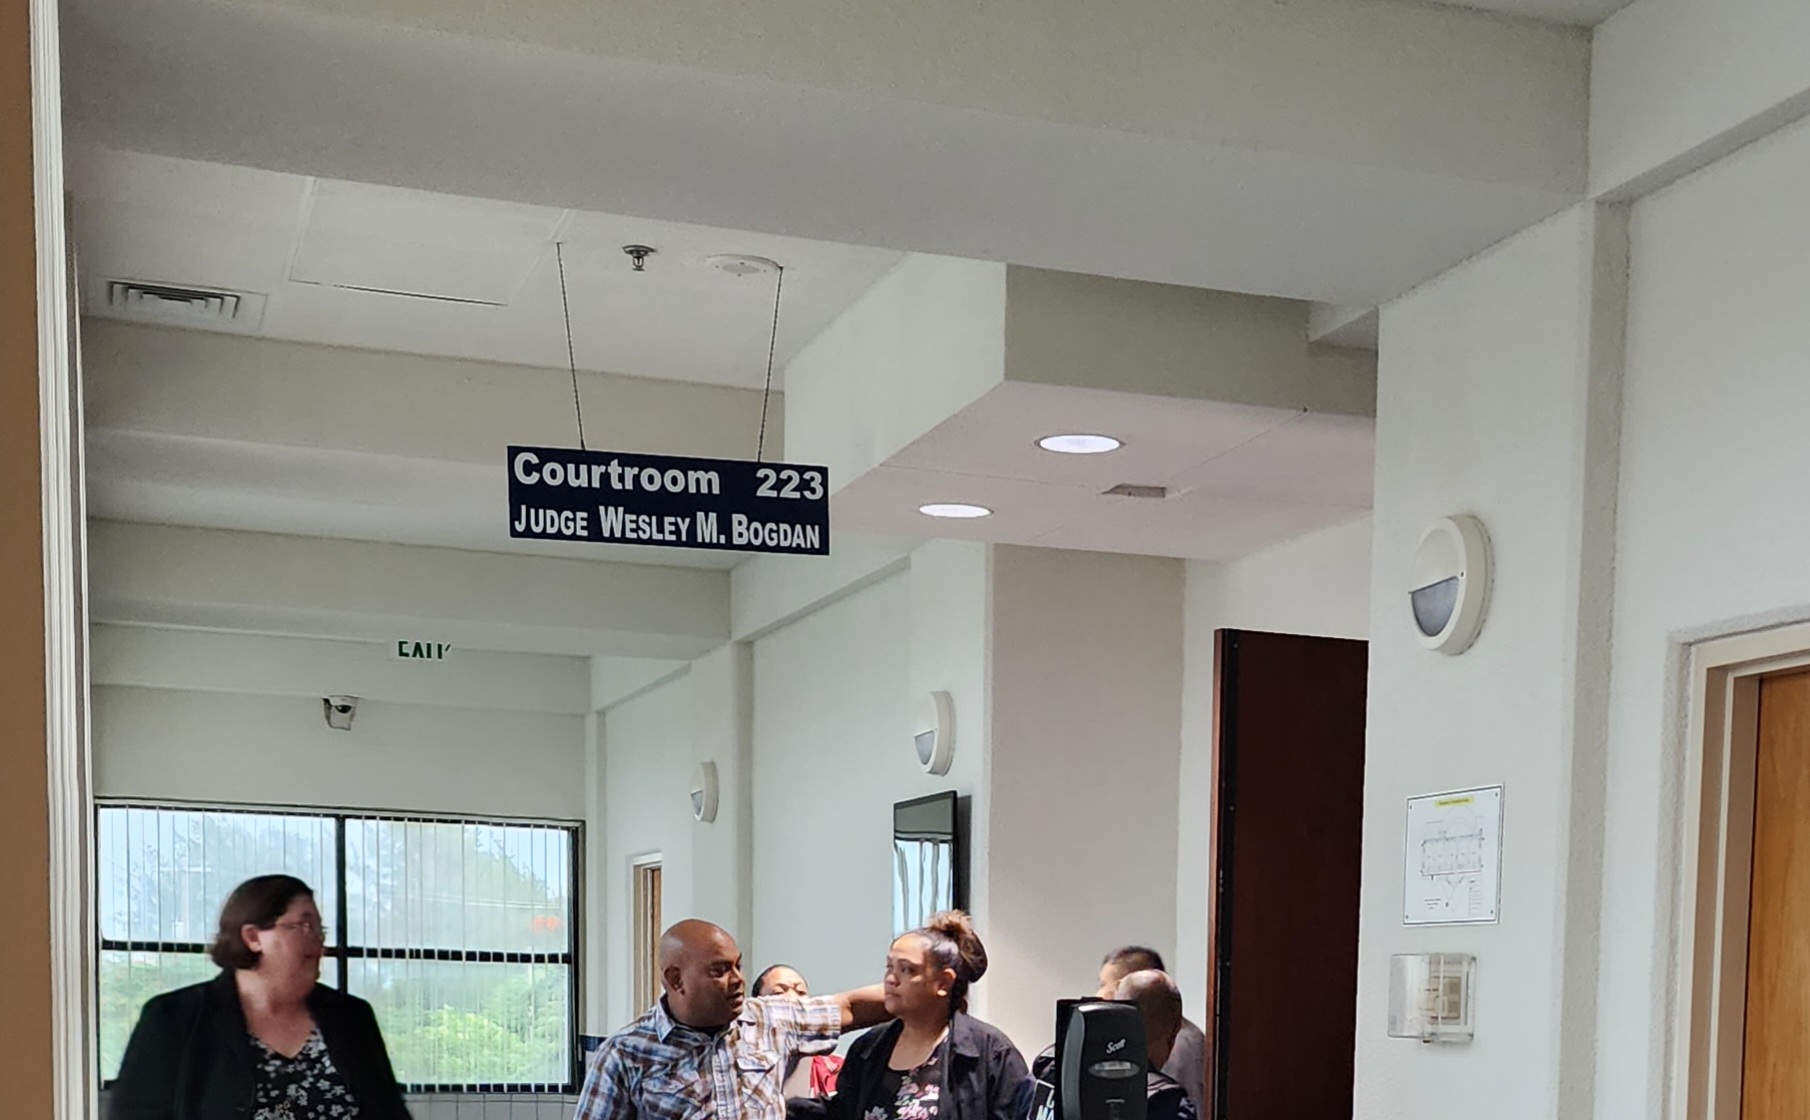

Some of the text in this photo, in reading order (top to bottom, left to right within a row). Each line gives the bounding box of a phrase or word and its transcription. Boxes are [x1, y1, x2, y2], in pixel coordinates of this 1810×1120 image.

[514, 451, 824, 500] Courtroom 223
[514, 504, 820, 549] JUDGE WESLEY M. BOGDAN
